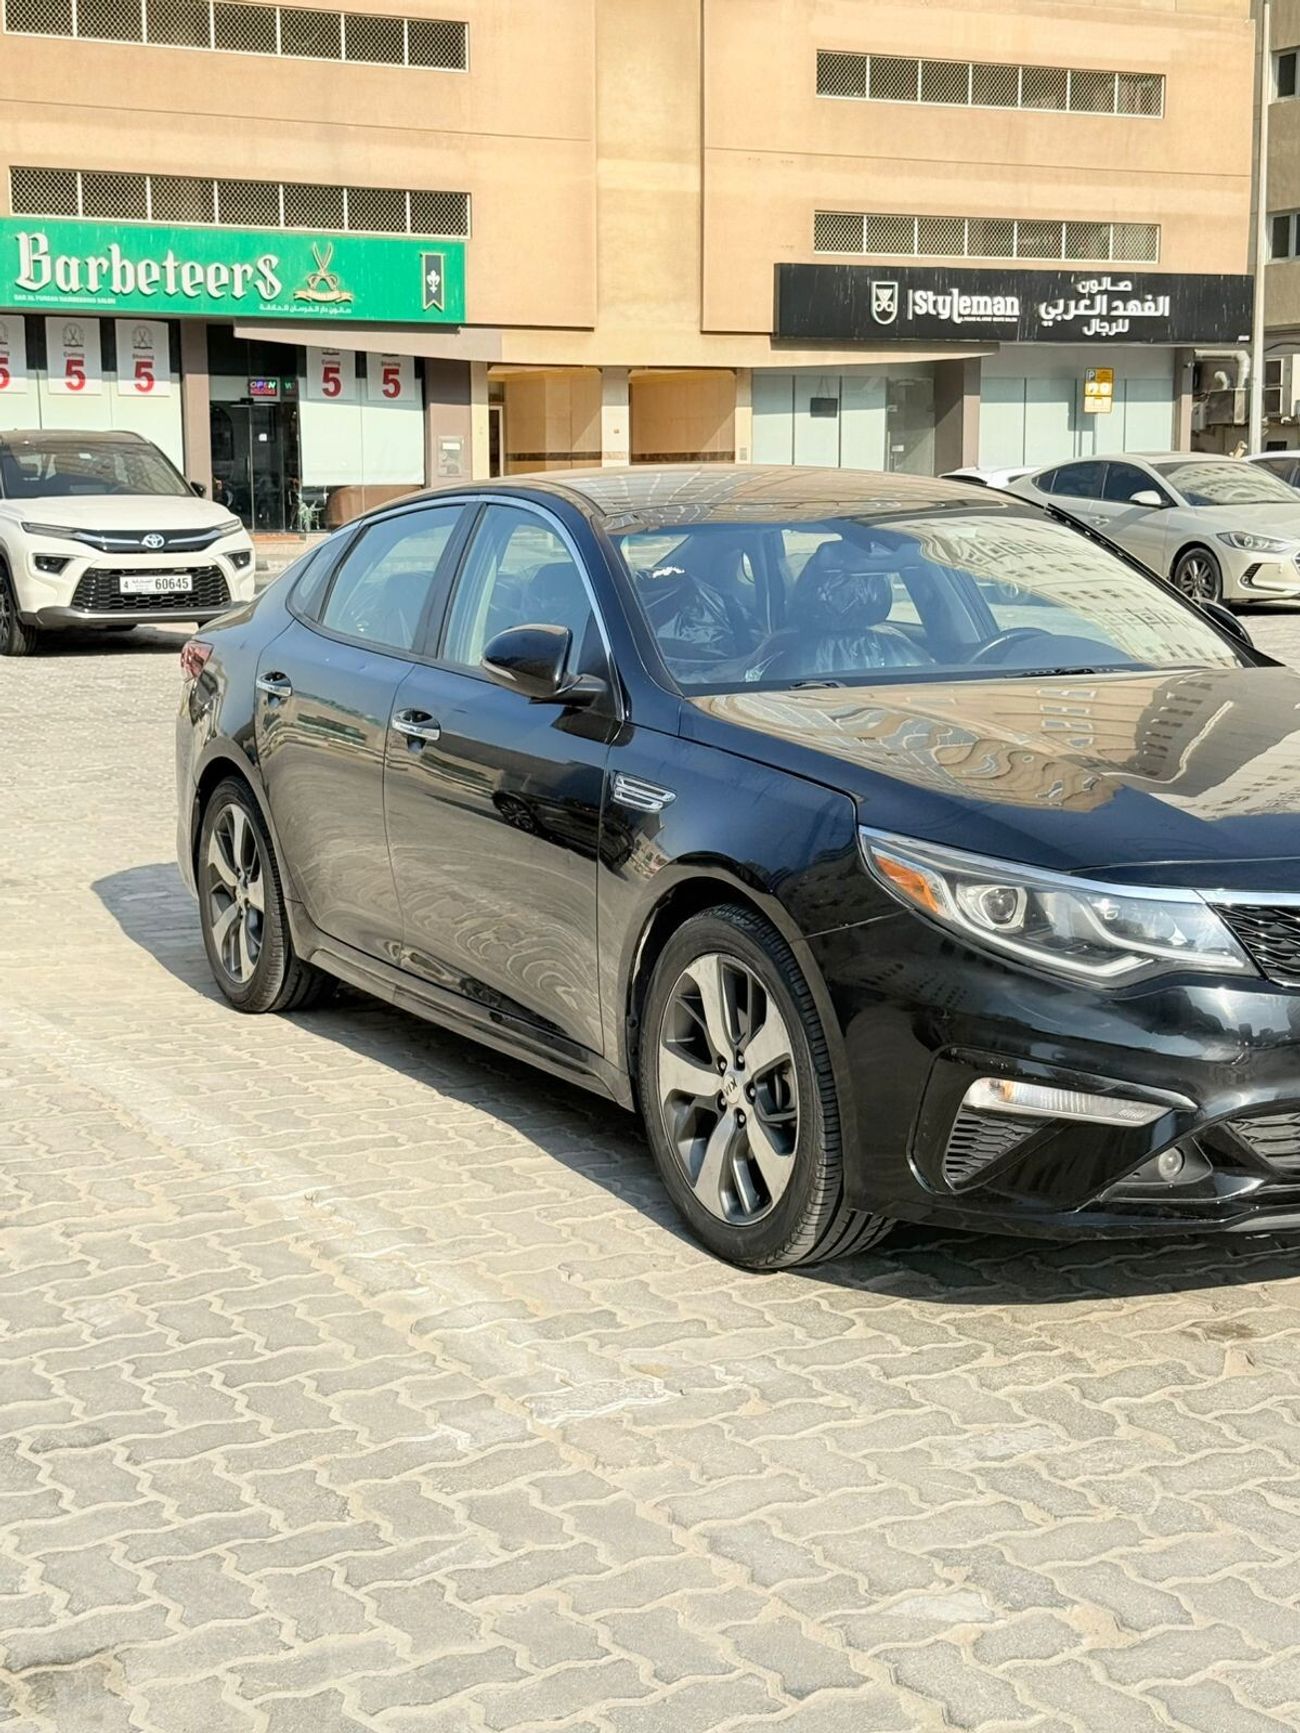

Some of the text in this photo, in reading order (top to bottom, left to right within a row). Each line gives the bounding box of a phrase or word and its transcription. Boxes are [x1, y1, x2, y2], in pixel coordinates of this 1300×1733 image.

[1077, 276, 1132, 293] صالون
[913, 288, 1020, 324] Styleman
[1038, 294, 1171, 327] الفهد العربي
[1082, 319, 1130, 337] للرجال
[65, 359, 86, 391] 5
[134, 361, 155, 393] 5
[249, 380, 276, 389] OPEN
[322, 367, 342, 398] 5
[382, 368, 401, 399] 5
[124, 580, 129, 589] 4
[155, 578, 188, 590] 60645
